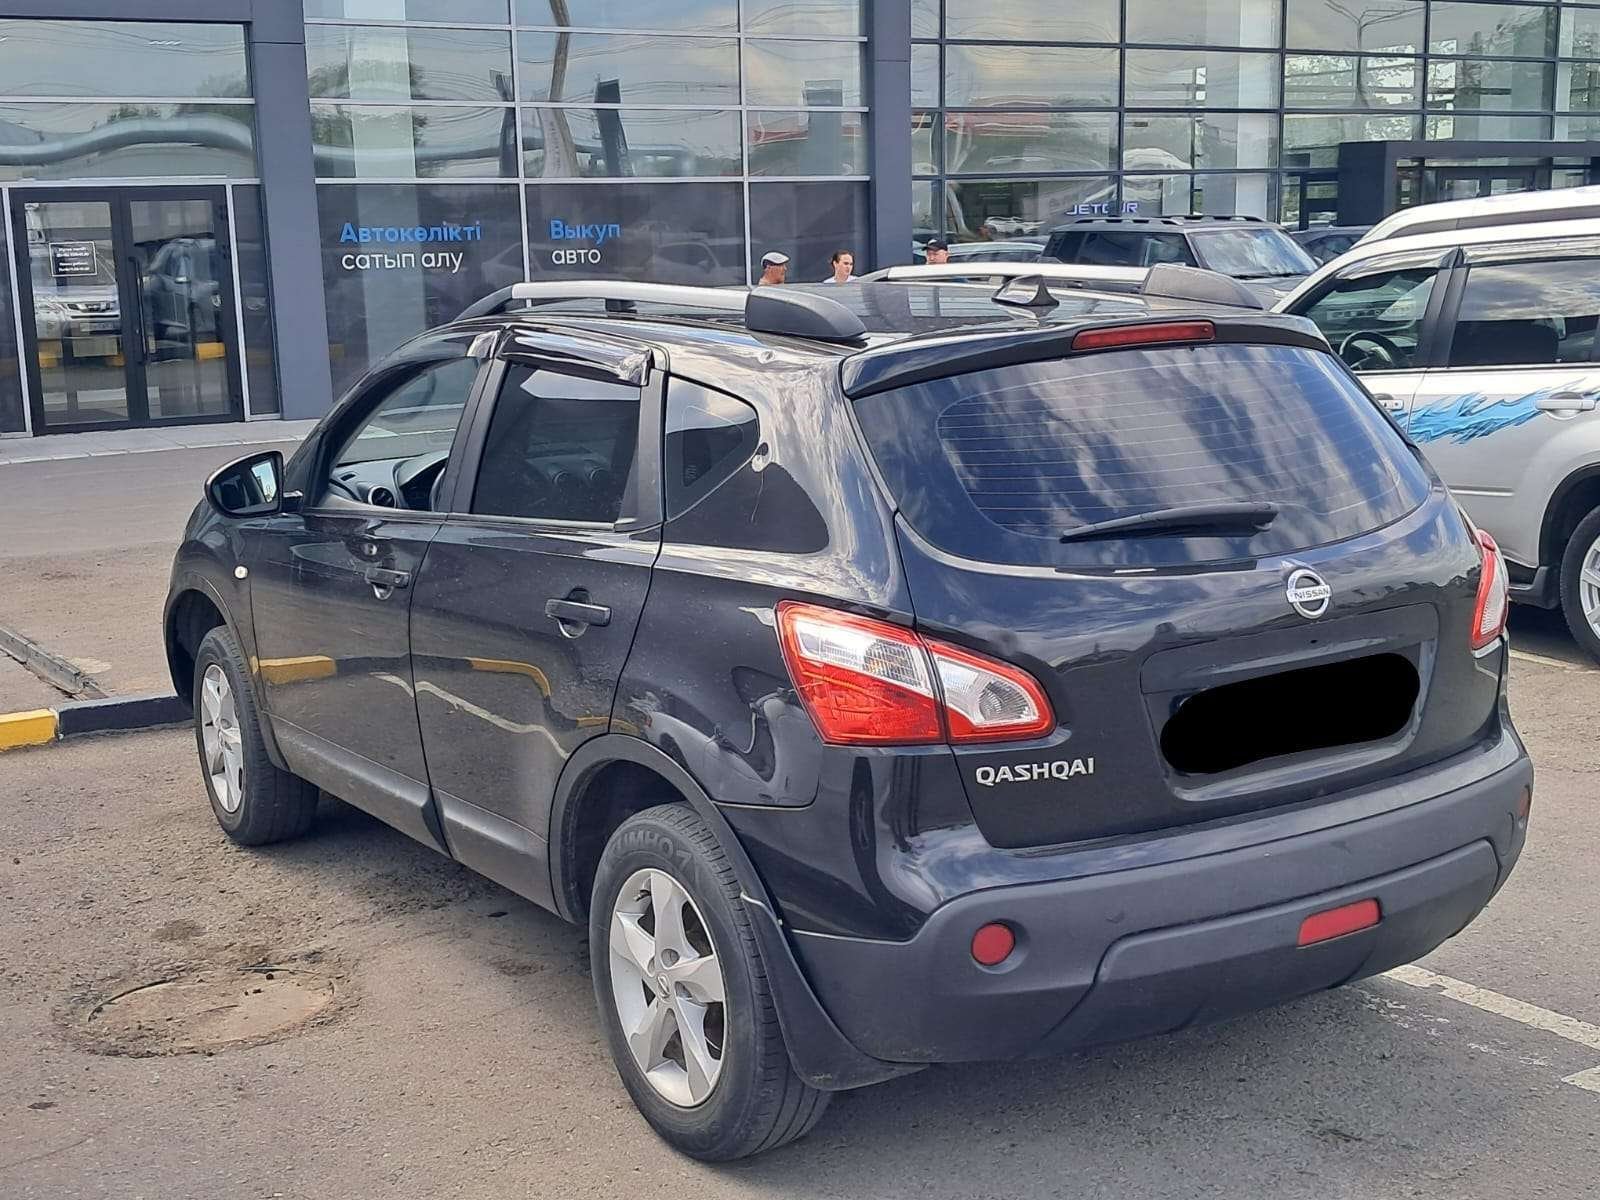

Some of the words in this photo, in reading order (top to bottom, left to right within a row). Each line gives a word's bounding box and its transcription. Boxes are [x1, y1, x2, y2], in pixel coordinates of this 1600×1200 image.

[340, 221, 481, 243] Автокөлікті
[550, 220, 621, 245] Выкуп
[341, 251, 415, 270] сатып
[421, 251, 463, 273] алу
[552, 248, 601, 265] авто
[1294, 588, 1329, 599] NISSAN
[975, 757, 1094, 786] QASHQAI
